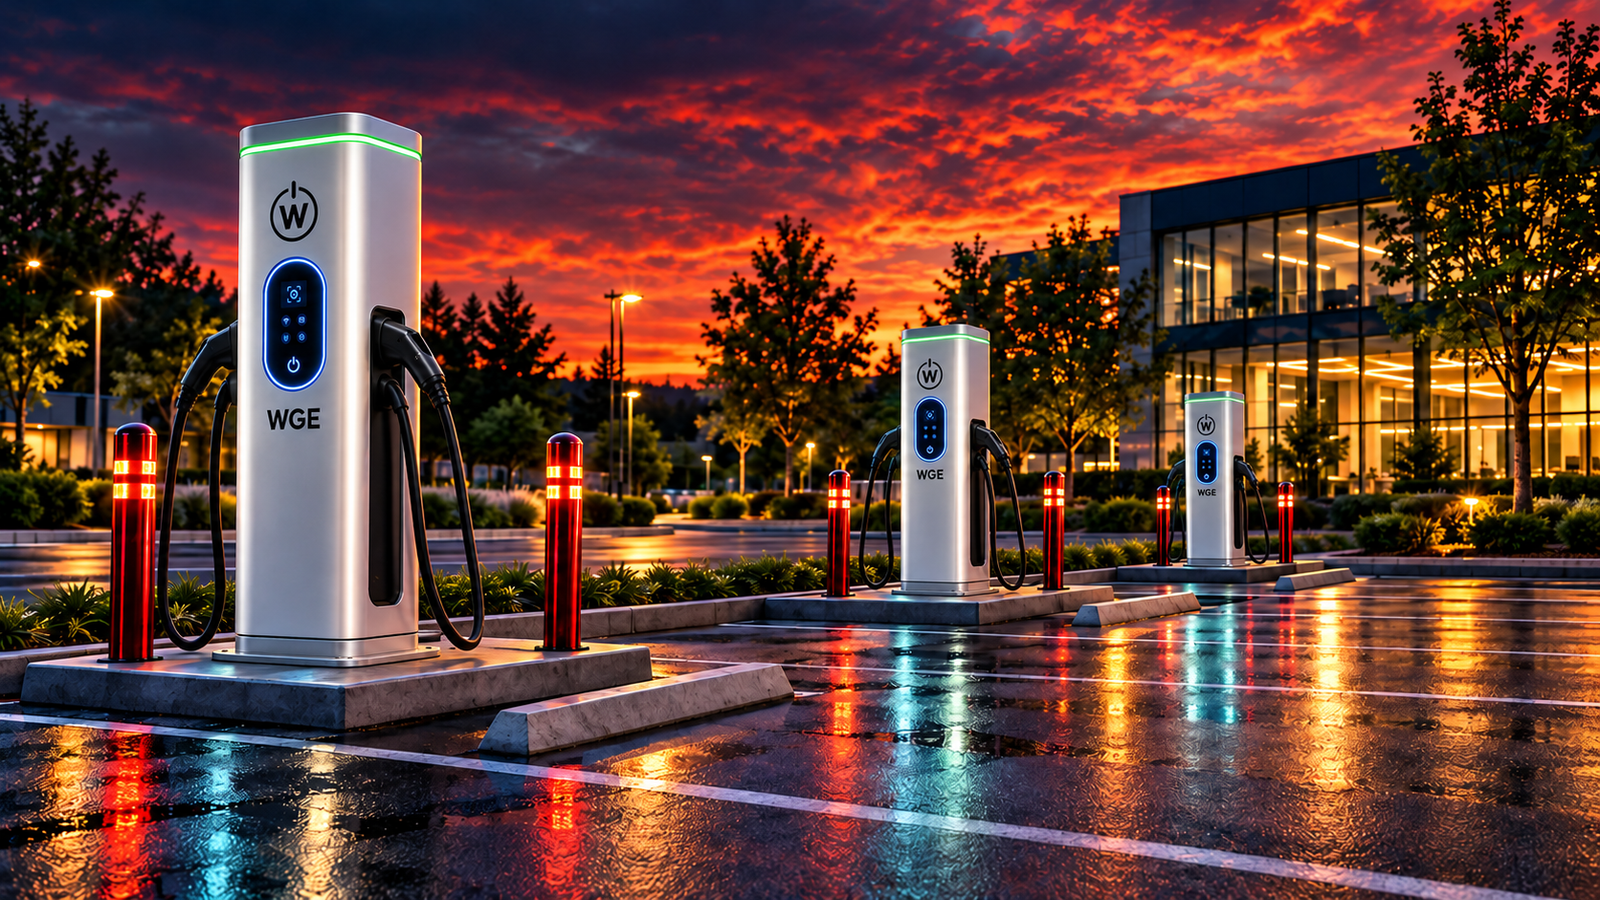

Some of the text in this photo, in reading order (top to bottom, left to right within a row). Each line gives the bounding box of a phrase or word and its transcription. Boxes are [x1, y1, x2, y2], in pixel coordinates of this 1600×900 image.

[279, 203, 309, 229] W
[922, 370, 938, 383] W
[267, 408, 321, 431] WGE
[1200, 421, 1212, 431] W
[917, 469, 944, 480] WGE
[1197, 489, 1217, 497] WGE
